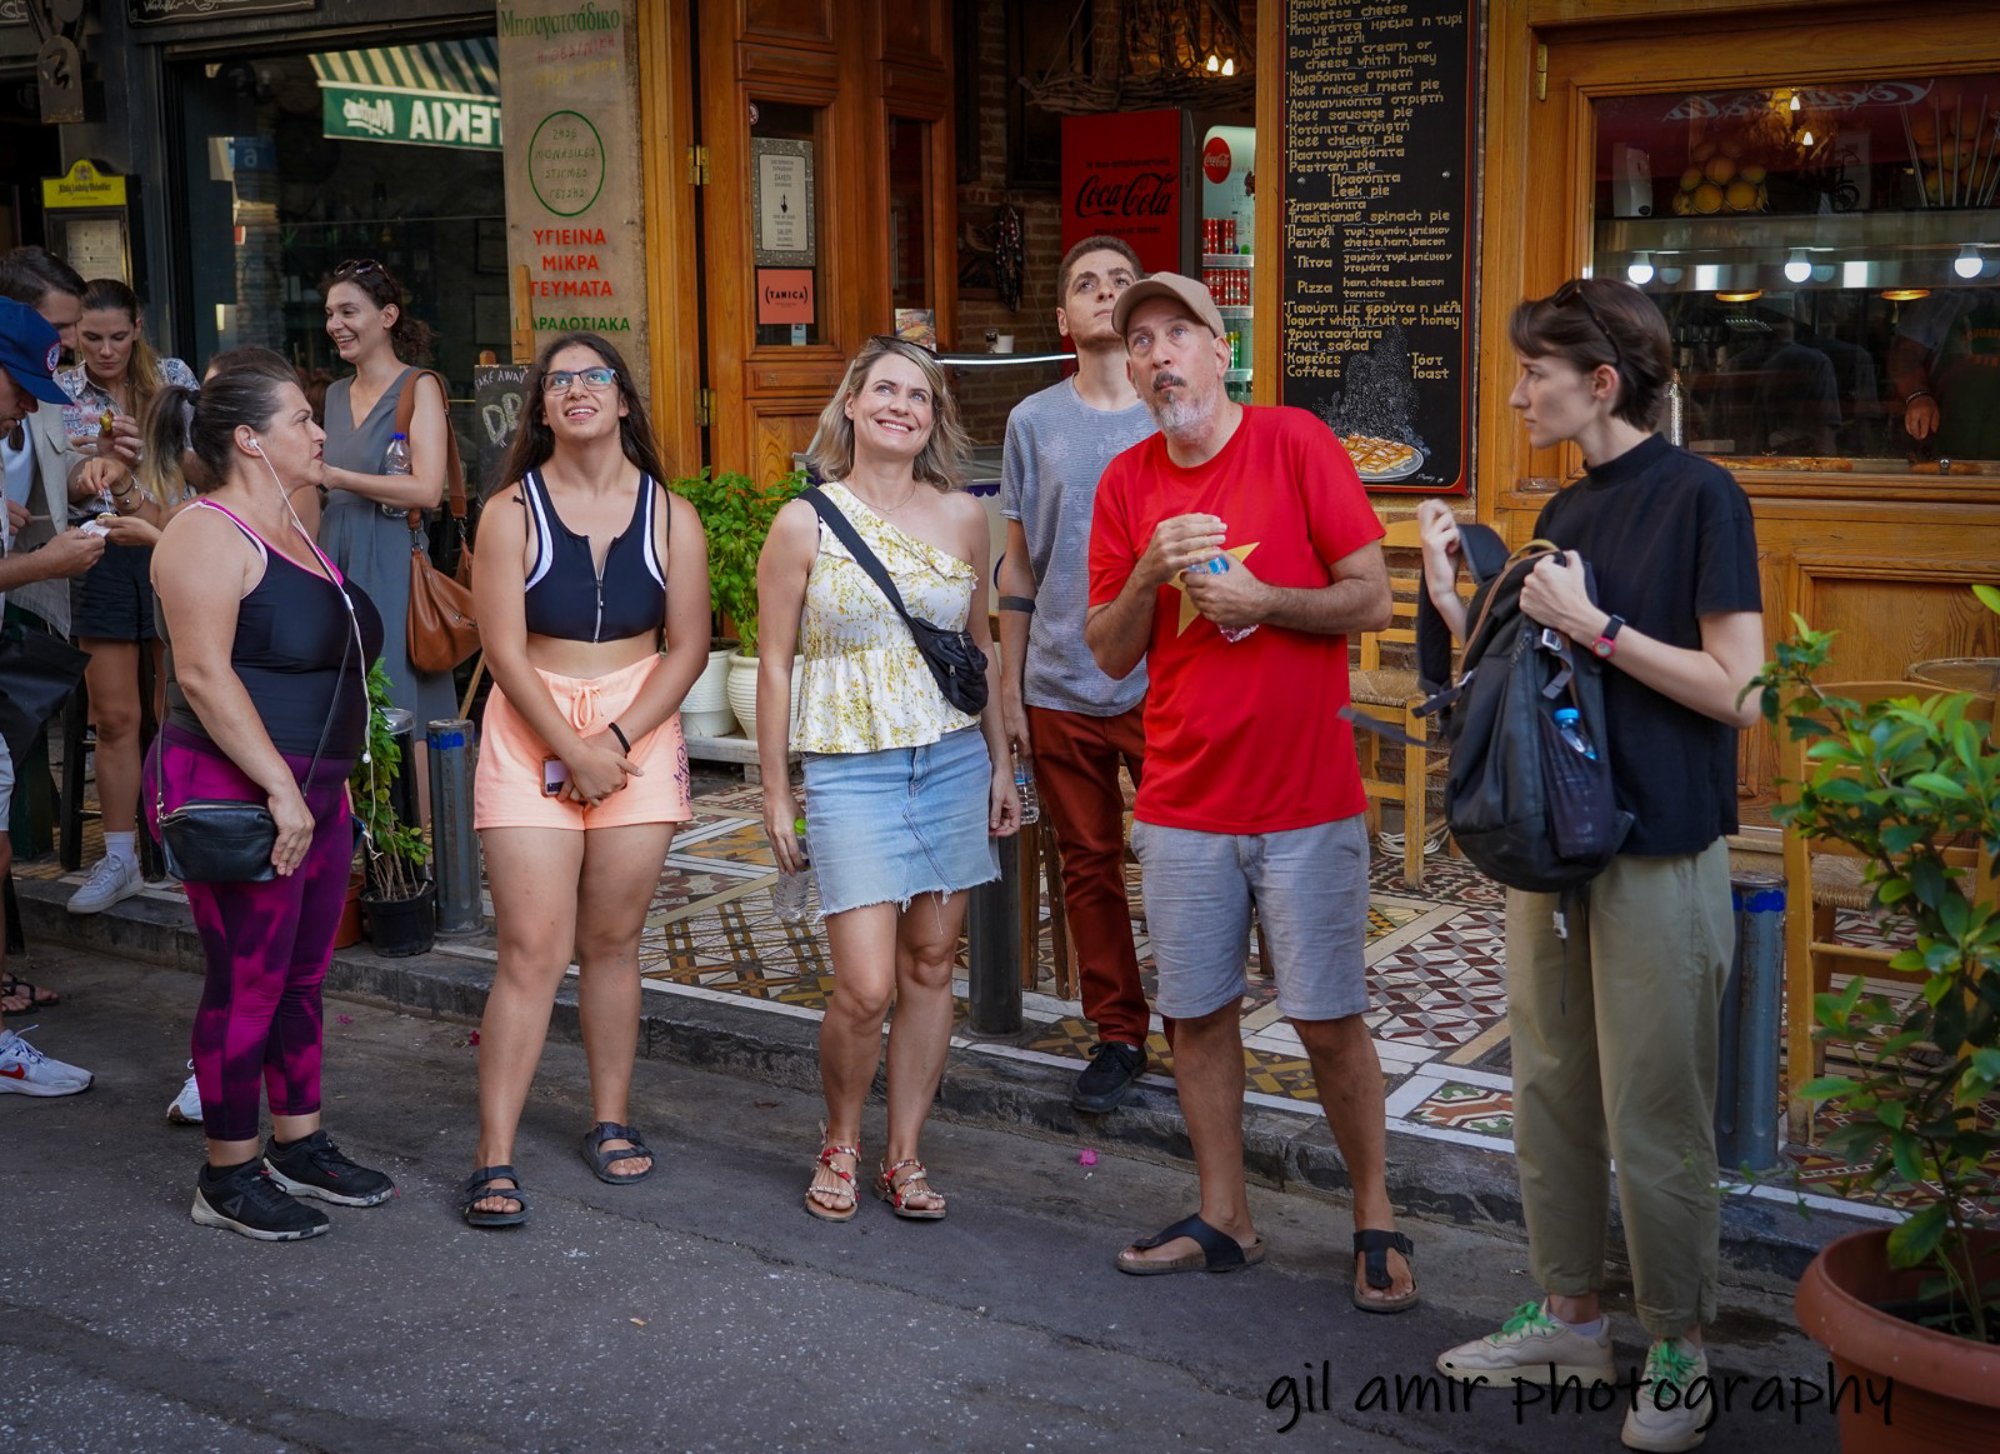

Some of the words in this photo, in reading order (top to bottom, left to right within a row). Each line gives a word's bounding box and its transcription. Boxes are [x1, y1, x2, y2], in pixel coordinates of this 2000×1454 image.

[501, 2, 620, 39] Μπουγατσάδικο
[1289, 10, 1351, 24] Bougatsa
[1360, 4, 1408, 17] cheese
[1437, 11, 1463, 27] τυρί
[1312, 37, 1329, 48] με
[1337, 31, 1365, 46] μέλι
[1290, 45, 1353, 59] Bougatsa
[1361, 42, 1408, 53] cream
[1417, 40, 1432, 49] or
[1305, 57, 1348, 69] cheese
[1357, 54, 1390, 66] whith
[1399, 53, 1437, 66] honey
[1289, 69, 1356, 85] Κιμαδόπιτα
[1290, 84, 1317, 97] Roll
[1322, 83, 1369, 95] minced
[1377, 82, 1413, 92] meat
[1421, 79, 1440, 92] pie
[1289, 109, 1319, 122] Roll
[1328, 109, 1385, 122] sausage
[1394, 107, 1413, 119] pie
[1290, 121, 1348, 135] Κοτόπιτα
[1289, 136, 1320, 147] Roll
[1327, 134, 1375, 146] chicken
[1383, 134, 1404, 146] pie
[1203, 153, 1230, 168] Coca-Cola
[1289, 161, 1348, 173] Pastram
[1357, 161, 1376, 173] pie
[1331, 172, 1401, 186] Πρασόπιτα
[1075, 172, 1177, 218] Coca-Cola
[1331, 185, 1363, 198] Leek
[1371, 186, 1390, 197] pie
[1288, 198, 1367, 212] Σπανακόπιτα
[1370, 210, 1422, 225] spinach
[1430, 211, 1450, 223] pie
[533, 229, 607, 245] ΥΓΙΕΙΝΑ
[542, 255, 599, 270] ΜΙΚΡΑ
[1297, 255, 1333, 269] Πίτσα
[1344, 263, 1390, 274] ντομάτα
[1297, 281, 1334, 294] Pizza
[1344, 290, 1386, 299] tomato
[1287, 301, 1339, 314] Γιαούρτι
[1343, 303, 1360, 315] με
[1433, 300, 1461, 314] μέλι
[1285, 313, 1325, 329] Yogurt
[1330, 314, 1360, 327] whith
[1365, 314, 1397, 327] fruit
[1401, 315, 1417, 325] or
[1421, 314, 1460, 330] honey
[1287, 340, 1319, 351] Fruit
[1328, 339, 1369, 352] salad
[1287, 352, 1341, 367] Καφέδες
[1412, 352, 1443, 366] Τόστ
[498, 369, 525, 388] AWAY
[1287, 366, 1341, 378] Coffees
[1412, 365, 1450, 379] Toast
